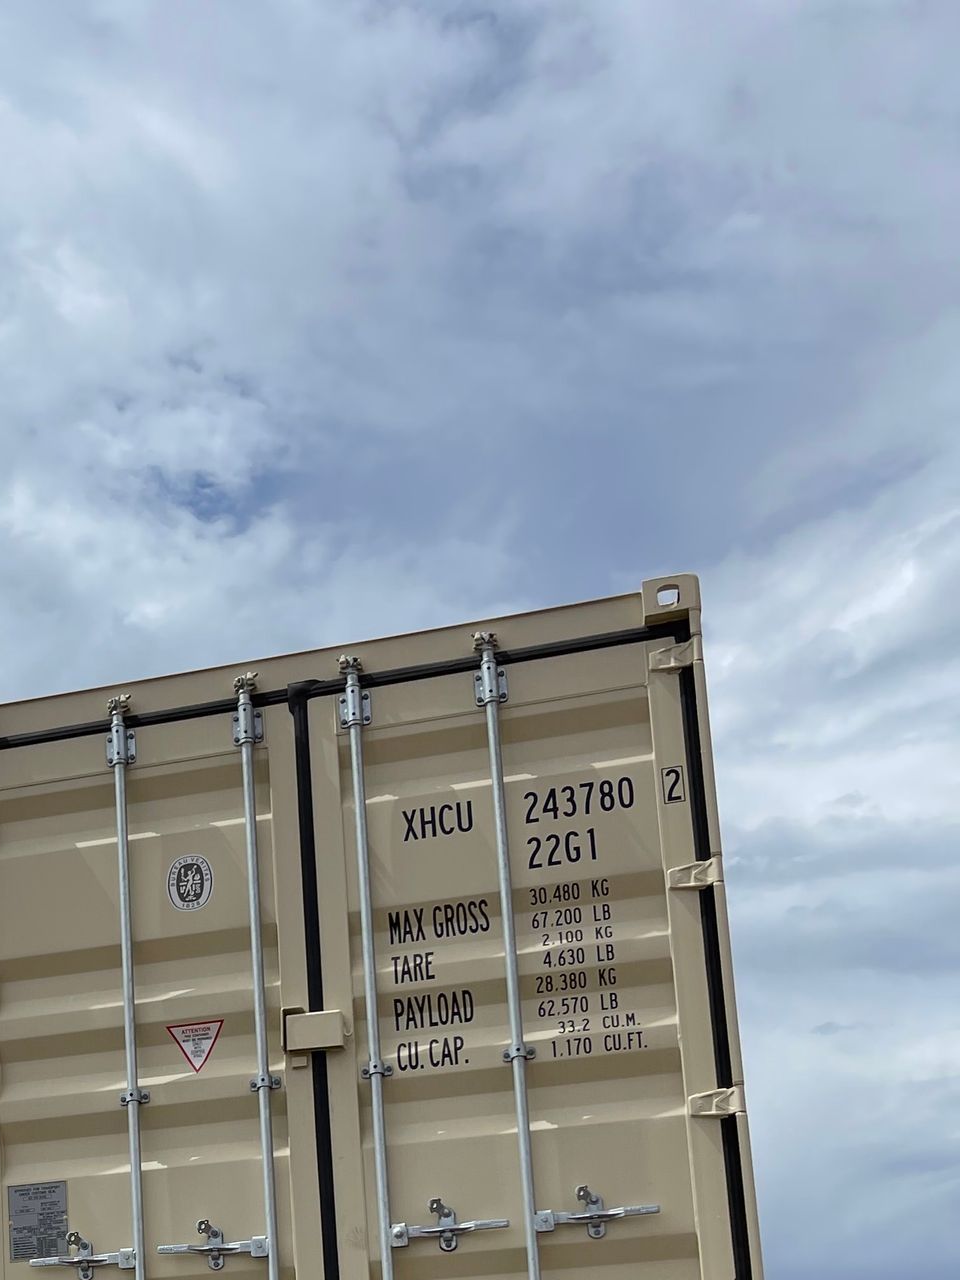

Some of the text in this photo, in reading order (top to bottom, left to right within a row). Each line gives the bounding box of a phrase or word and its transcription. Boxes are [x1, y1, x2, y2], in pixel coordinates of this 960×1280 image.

[401, 768, 683, 842] XHCU 243780 2
[526, 827, 597, 870] 22G1
[591, 878, 610, 898] KG
[387, 898, 490, 945] MAX GROSS
[592, 903, 611, 922] LB
[594, 925, 613, 940] KG
[596, 943, 615, 962] LB
[390, 951, 436, 985] TARE
[598, 967, 617, 987] KG
[393, 989, 474, 1032] PAYLOAD
[600, 992, 619, 1011] LB
[181, 1026, 211, 1035] ATTENTION
[557, 1013, 641, 1034] 33.2 CU.M.
[604, 1031, 648, 1052] CU.FT.
